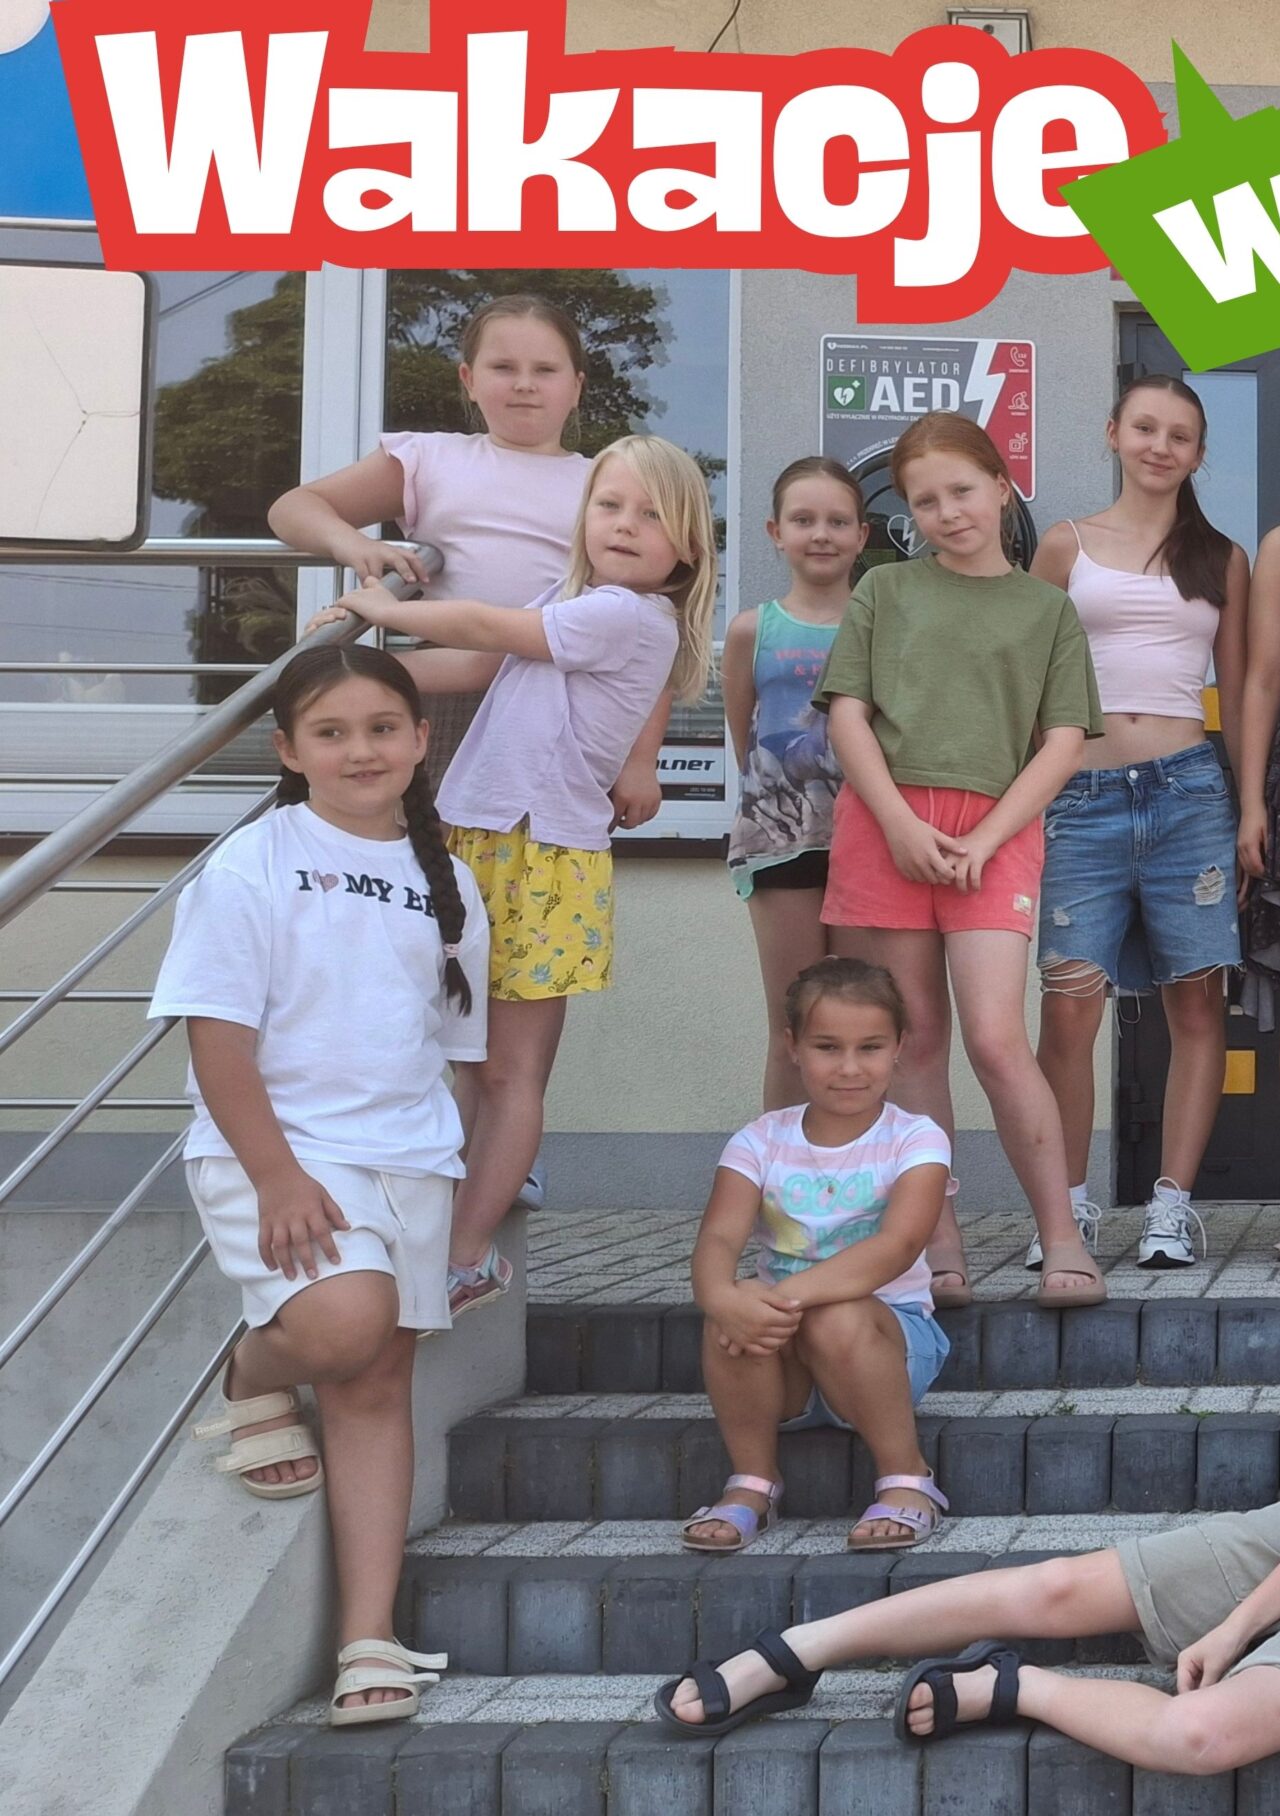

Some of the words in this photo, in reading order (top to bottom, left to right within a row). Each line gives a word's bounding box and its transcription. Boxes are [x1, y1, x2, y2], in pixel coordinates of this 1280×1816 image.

[826, 358, 960, 376] DEFIBRYLATOR
[869, 376, 960, 413] AED
[295, 869, 313, 891] I
[342, 872, 394, 903] MY
[780, 1170, 876, 1218] COOL
